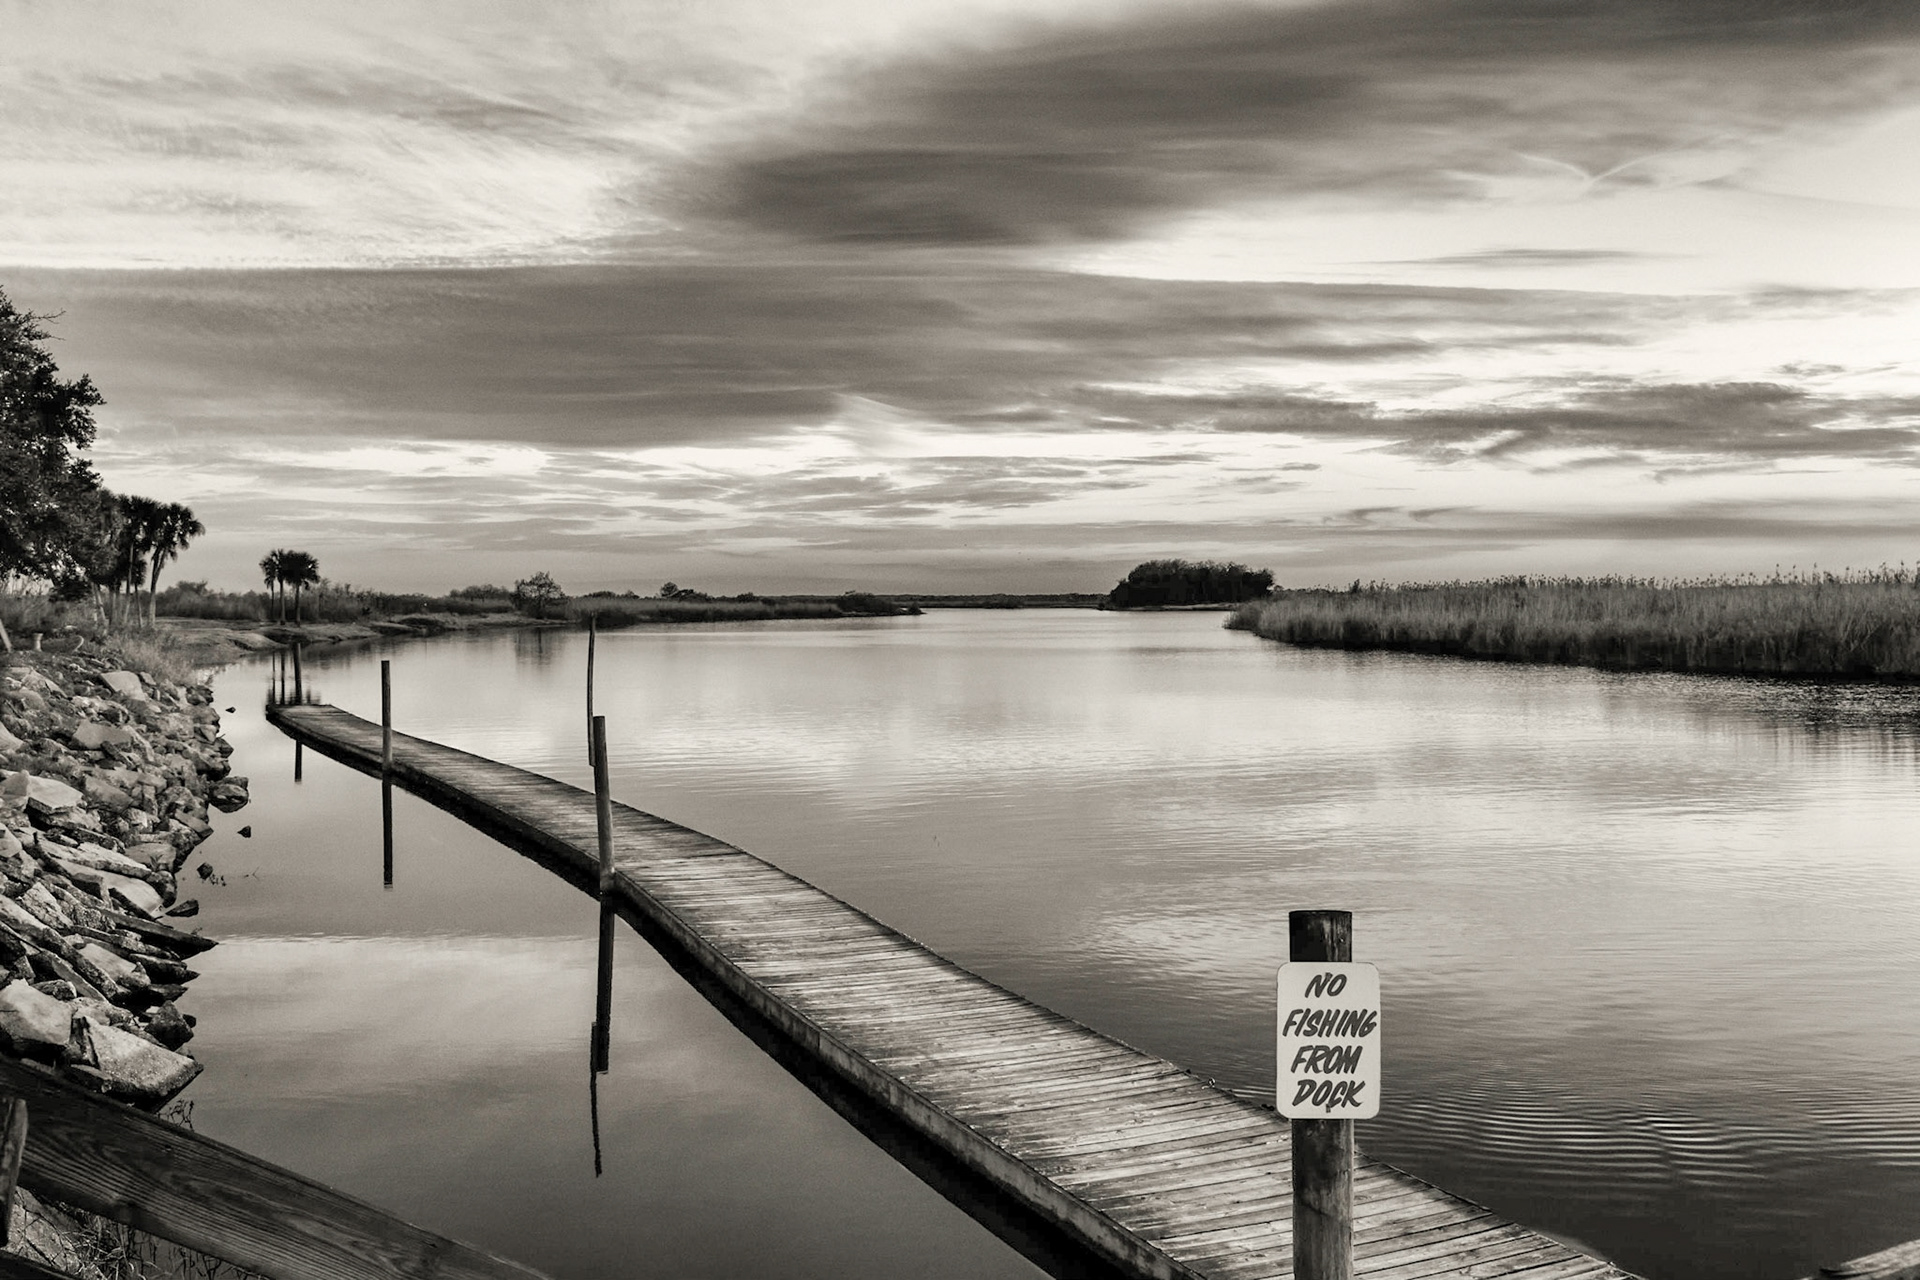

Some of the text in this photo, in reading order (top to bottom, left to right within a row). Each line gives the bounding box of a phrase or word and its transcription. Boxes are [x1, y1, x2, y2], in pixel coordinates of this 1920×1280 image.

[1305, 973, 1347, 998] NO
[1283, 1008, 1378, 1038] FISHING
[1291, 1045, 1363, 1074] FROM
[1292, 1079, 1365, 1107] DOCK
